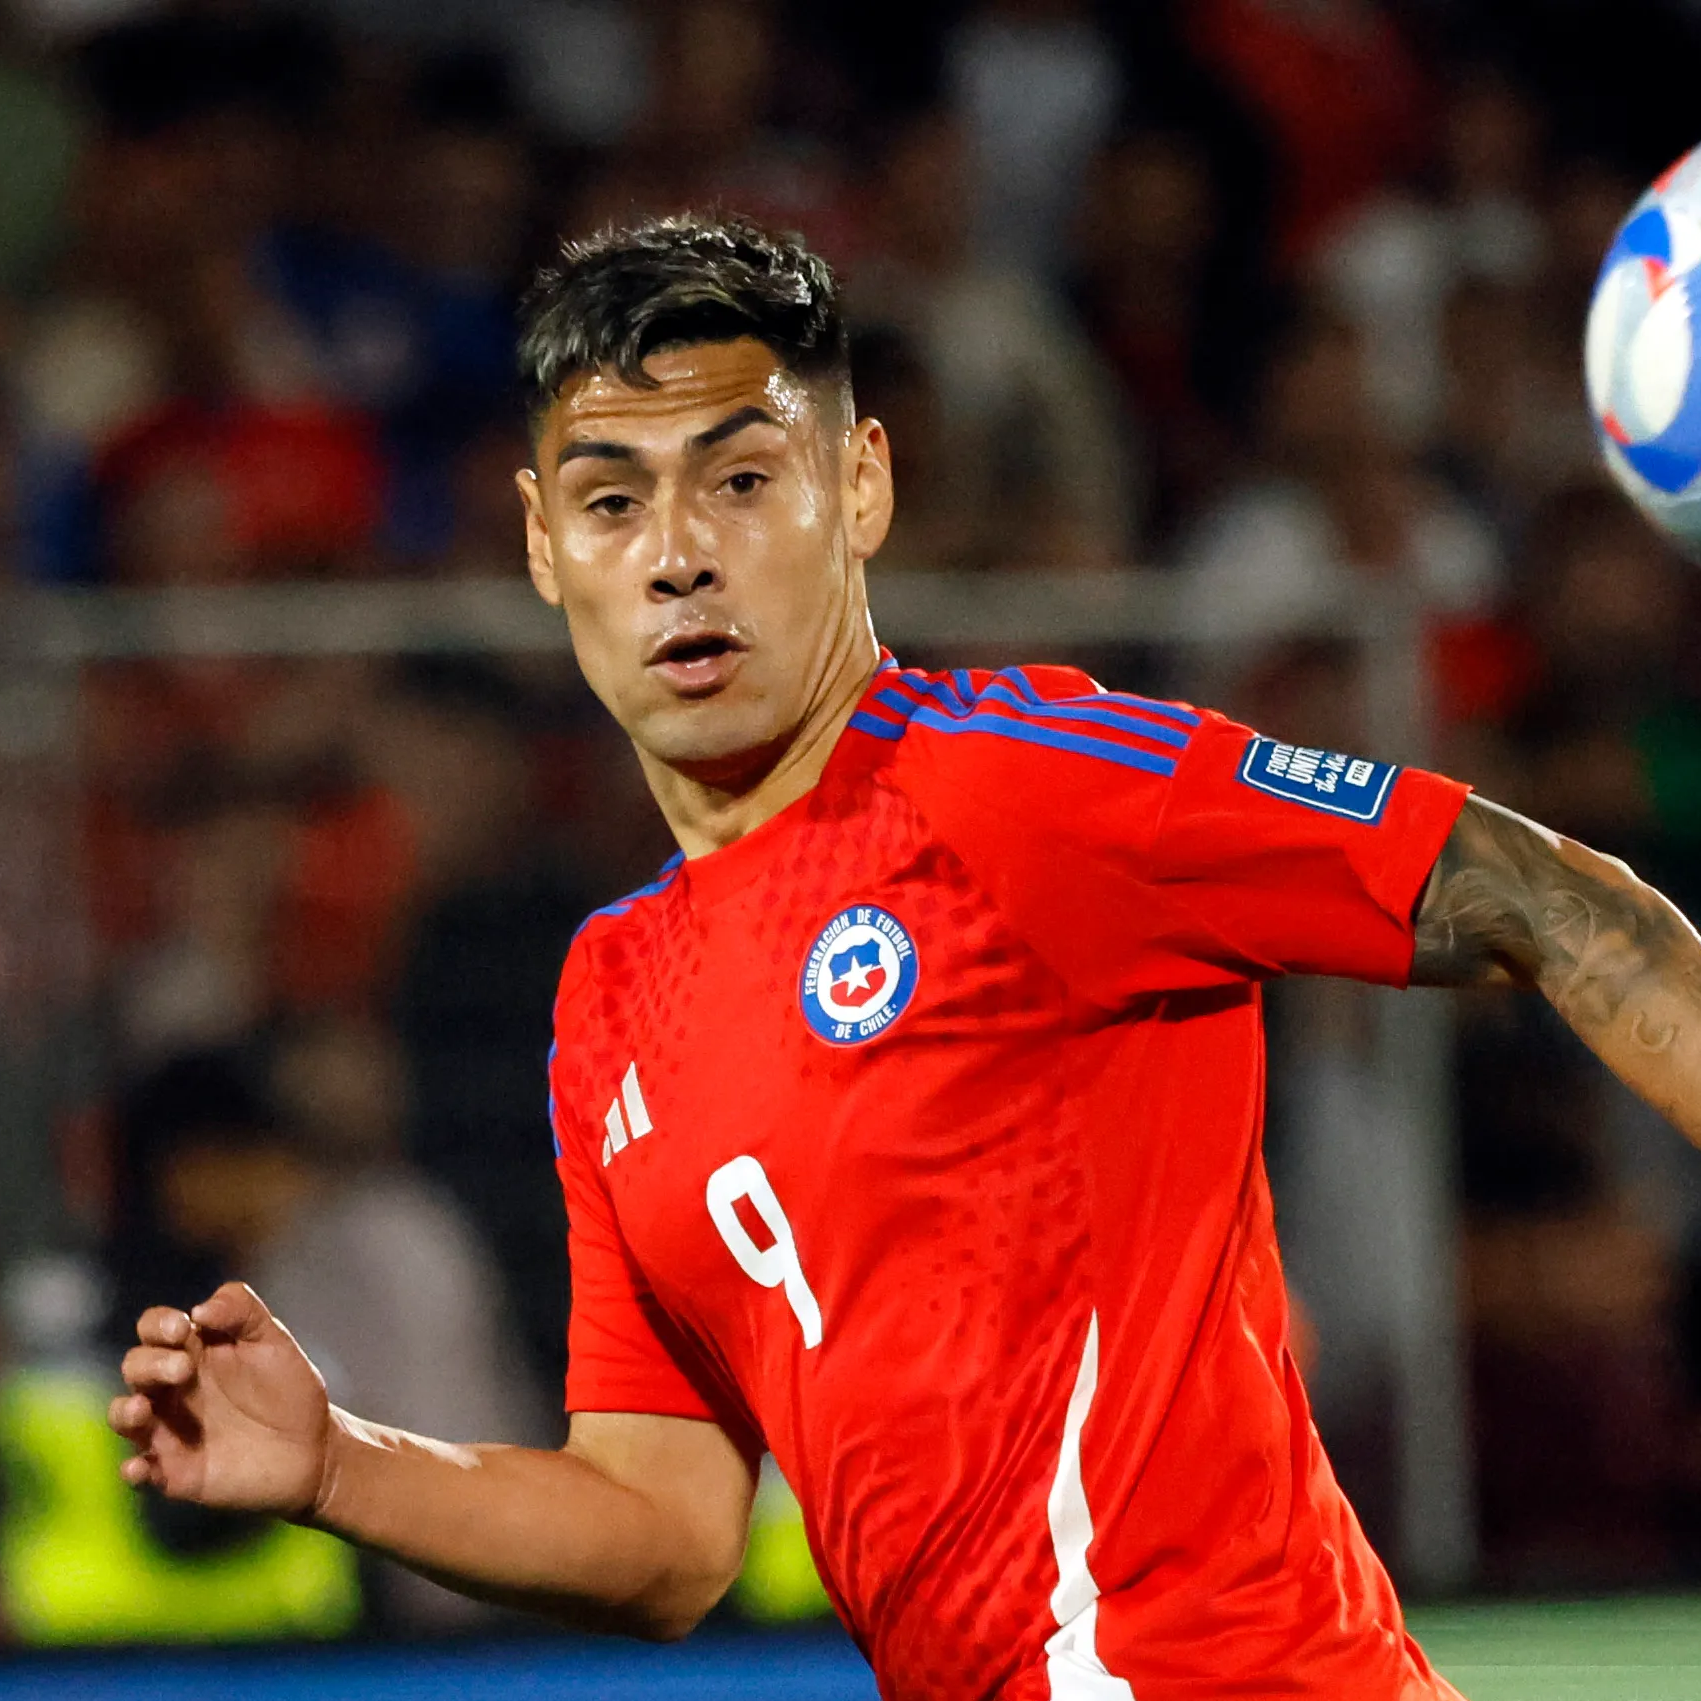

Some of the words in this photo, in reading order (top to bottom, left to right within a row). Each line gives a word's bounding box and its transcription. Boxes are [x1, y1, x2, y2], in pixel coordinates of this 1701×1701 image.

[1266, 744, 1295, 777] FOOTB
[1286, 746, 1324, 785] UNIT
[804, 913, 850, 996] FEDERACION
[856, 908, 872, 925] DE
[875, 913, 913, 961] FUTBOL
[834, 1023, 853, 1040] DE
[859, 1006, 896, 1037] CHILE
[705, 1153, 822, 1350] 9
